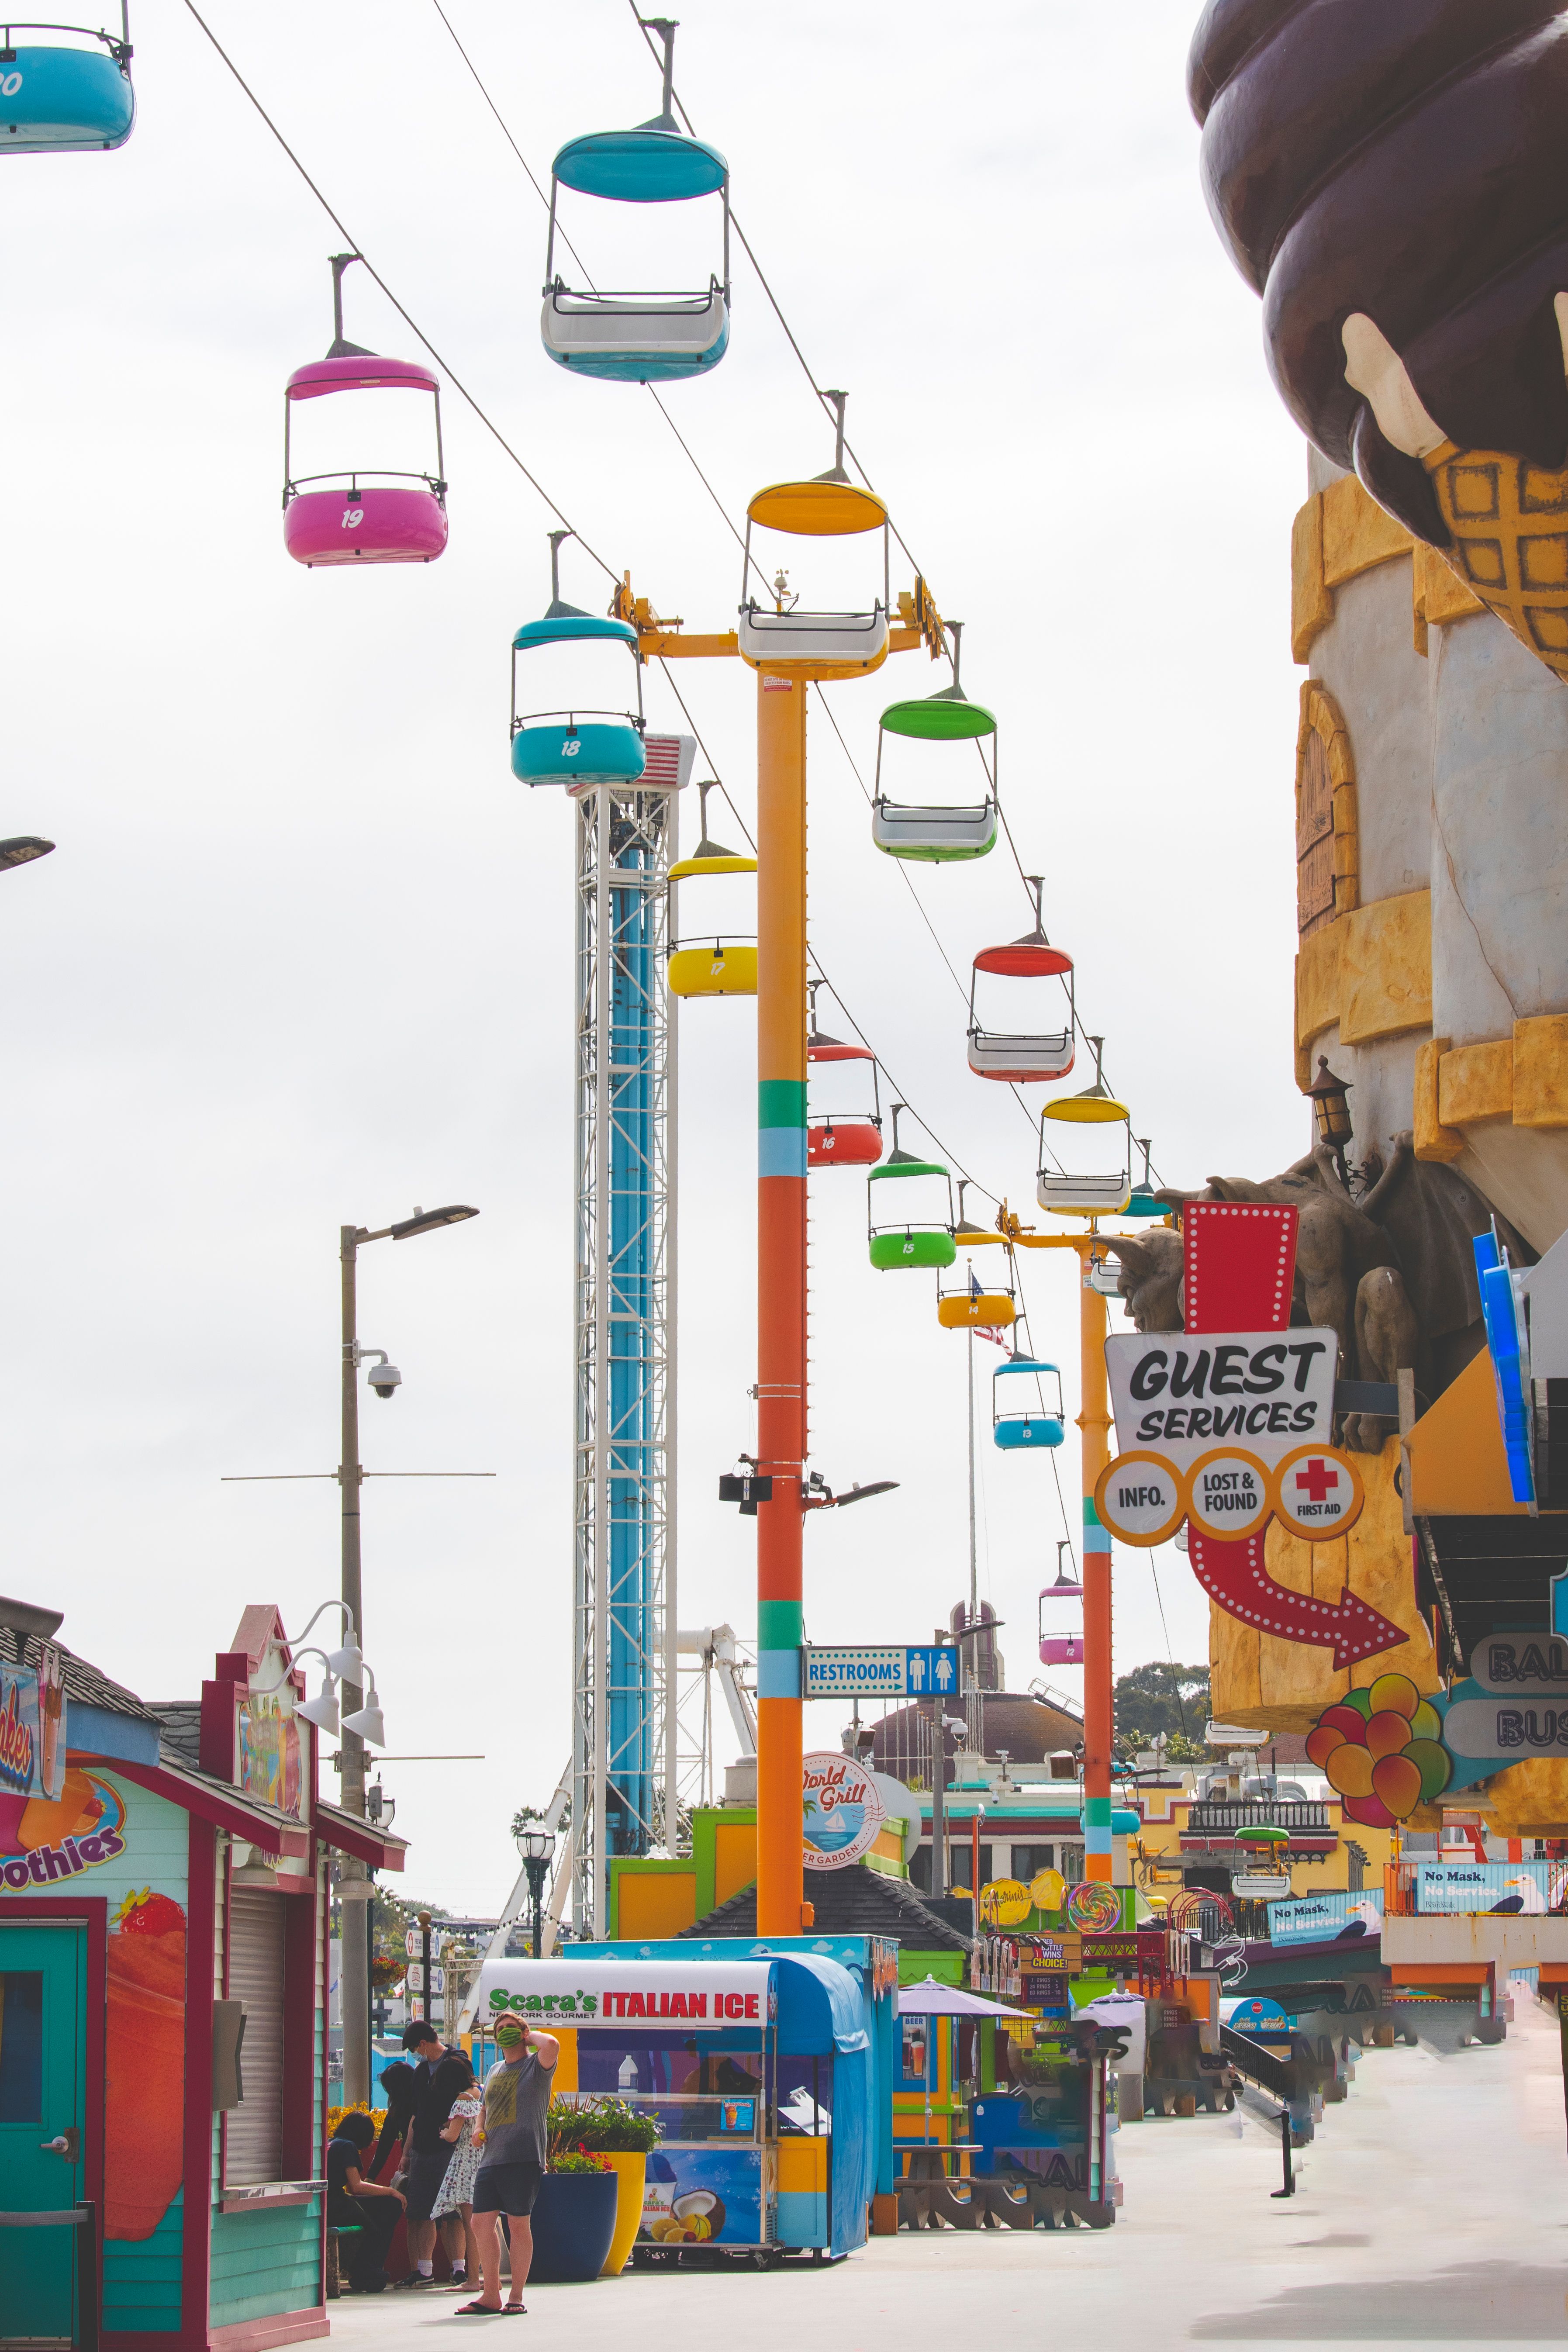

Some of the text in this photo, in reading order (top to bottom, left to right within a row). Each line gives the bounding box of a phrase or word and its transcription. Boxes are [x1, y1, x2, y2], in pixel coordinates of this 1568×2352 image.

[342, 509, 364, 528] 19
[561, 740, 581, 756] 18
[710, 962, 725, 975] 17
[822, 1137, 836, 1149] 16
[902, 1243, 915, 1254] 15
[969, 1306, 979, 1315] 14
[1130, 1342, 1326, 1400] GUEST
[1136, 1401, 1318, 1441] SERVICES
[1022, 1429, 1032, 1438] 13
[1203, 1472, 1254, 1491] LOST &
[1119, 1486, 1166, 1508] INFO.
[1205, 1492, 1257, 1512] FOUND
[1297, 1503, 1341, 1516] FIRST AID
[809, 1663, 901, 1681] RESTROOMS
[820, 1783, 867, 1811] Grill
[0, 1827, 124, 1888] othies
[803, 1844, 859, 1864] ER GARDEN
[1425, 1872, 1485, 1883] No Mask,
[984, 1887, 1030, 1912] Marini's
[1425, 1886, 1501, 1896] No Service.
[1274, 1904, 1329, 1918] No Mask,
[1276, 1917, 1344, 1932] No Service.
[1033, 1958, 1068, 1968] CHOICE!
[489, 1988, 597, 2011] Scara's
[603, 1992, 759, 2019] ITALIAN ICE
